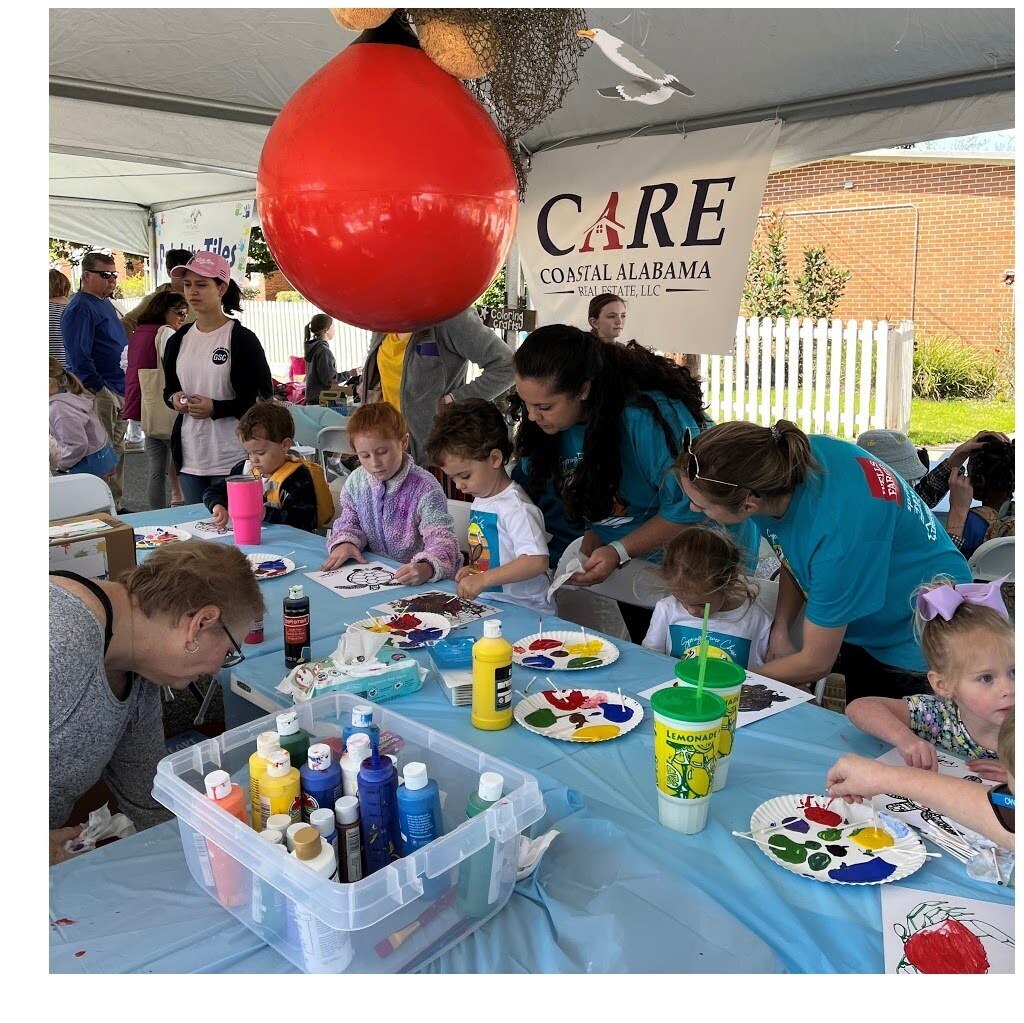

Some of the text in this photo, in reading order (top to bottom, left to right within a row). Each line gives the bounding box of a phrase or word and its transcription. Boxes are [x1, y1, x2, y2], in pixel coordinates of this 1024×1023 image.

[536, 176, 736, 257] CARE
[540, 260, 712, 285] COASTAL ALABAMA
[640, 284, 661, 297] LLC
[666, 729, 717, 743] LEMONADE
